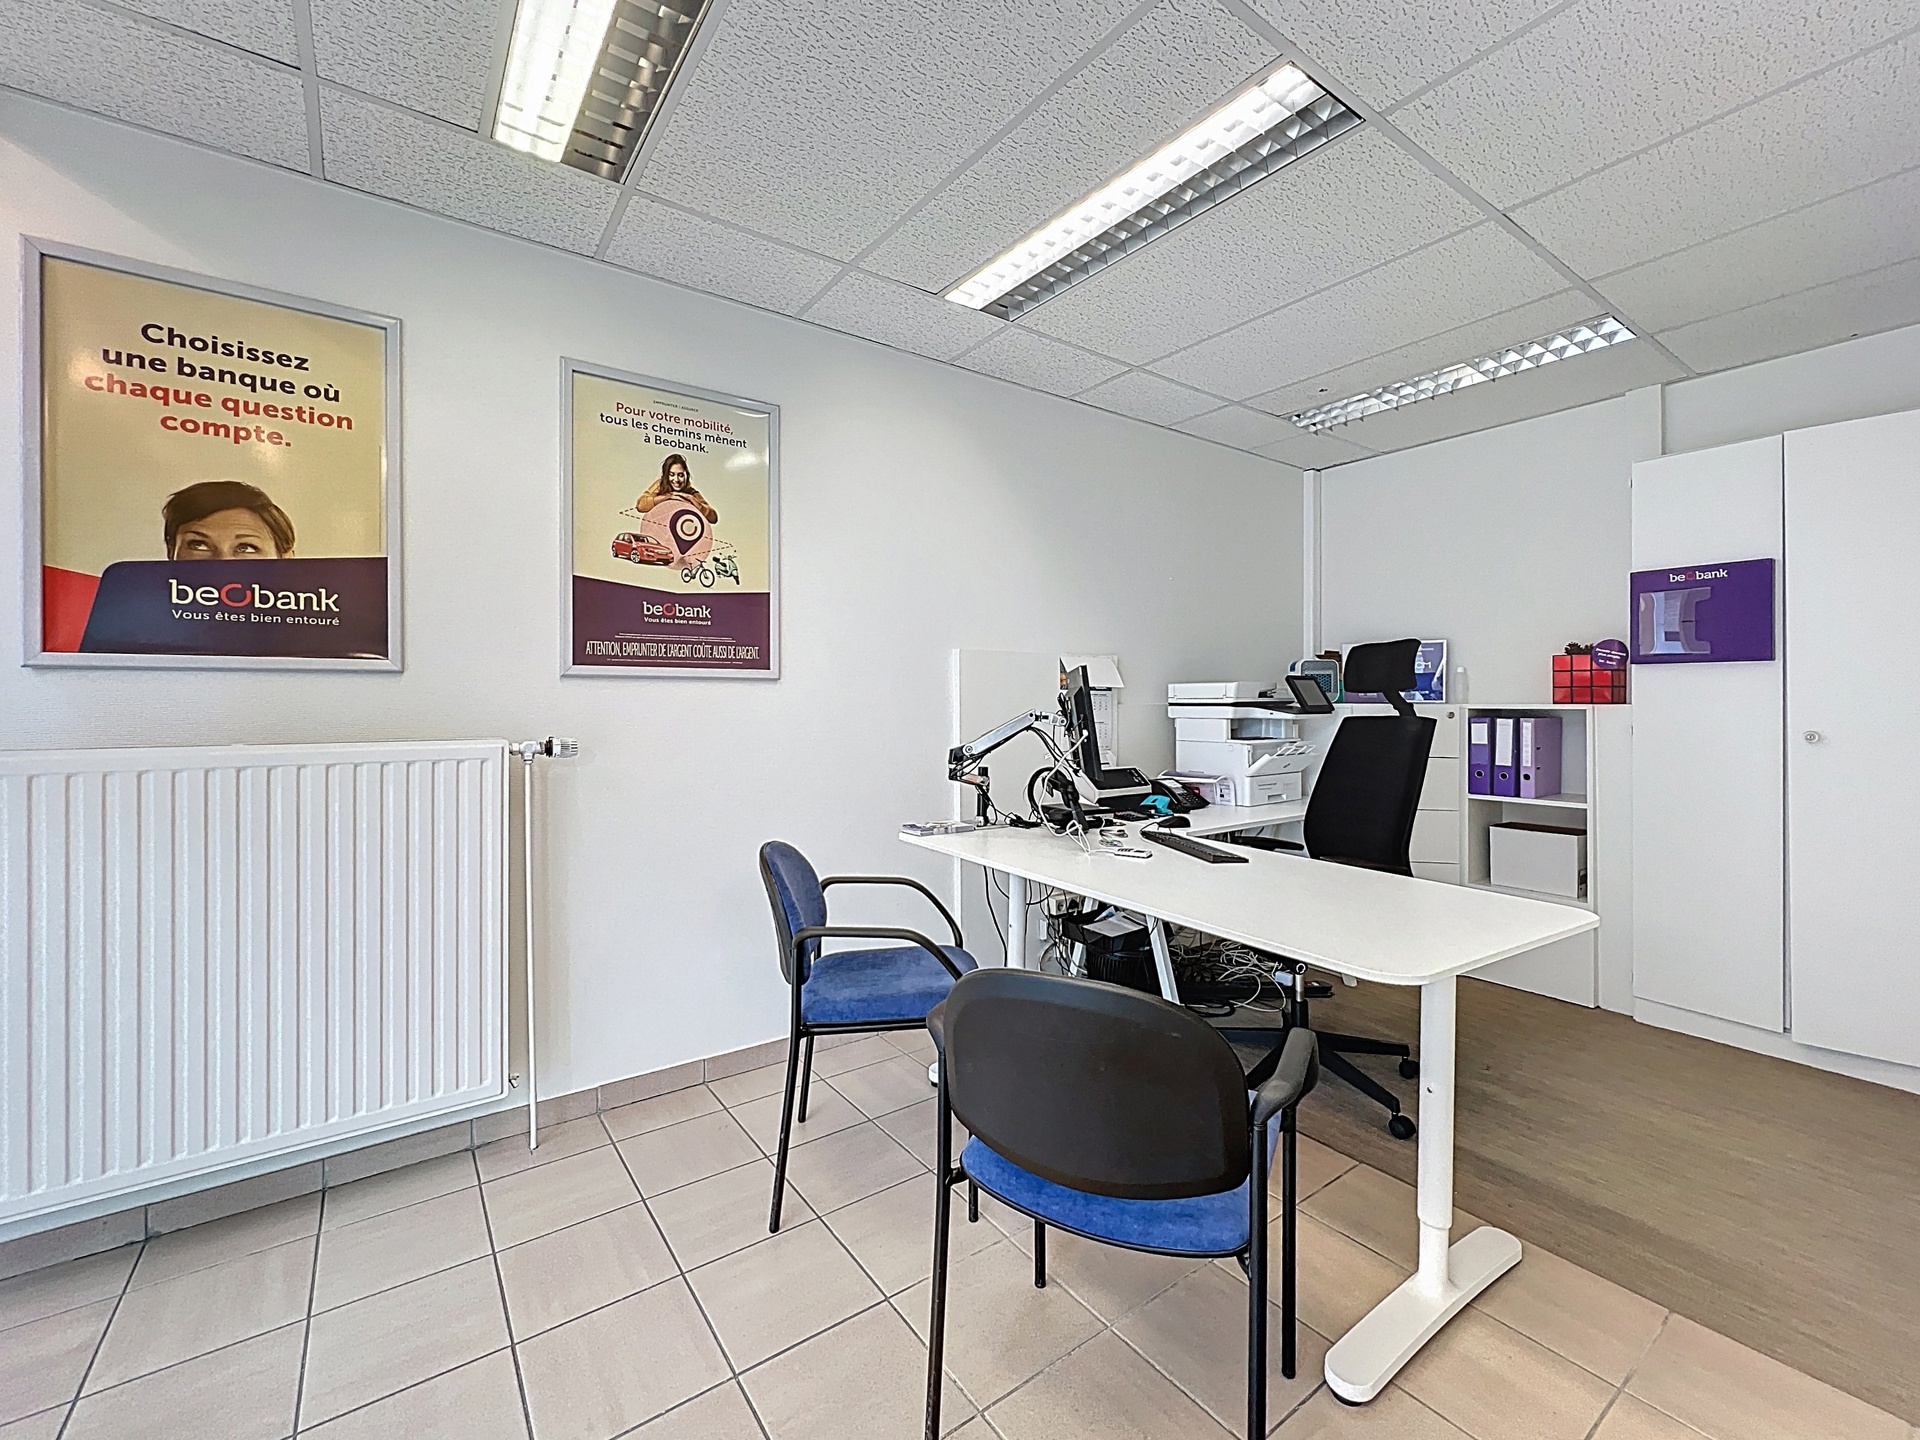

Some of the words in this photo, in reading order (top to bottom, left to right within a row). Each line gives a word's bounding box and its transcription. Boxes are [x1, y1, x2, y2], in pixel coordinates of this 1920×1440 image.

[141, 323, 309, 371] Choisissez
[102, 348, 167, 373] une
[177, 356, 296, 395] banque
[303, 383, 340, 402] où
[84, 373, 212, 407] chaque
[221, 396, 353, 430] question
[160, 415, 292, 447] compte.
[600, 412, 628, 427] tous
[631, 418, 649, 430] les
[651, 423, 701, 440] chemins
[704, 434, 747, 448] mènent
[616, 402, 646, 416] Pour
[648, 411, 680, 424] votre
[684, 417, 734, 435] mobilité,
[643, 433, 651, 443] à
[654, 434, 709, 454] Beobank.
[172, 609, 210, 620] Vous
[215, 611, 246, 622] êtes
[251, 612, 281, 624] bien
[286, 615, 340, 626] entouré
[586, 640, 622, 657] ATTENTION,
[622, 641, 658, 657] EMPRUNTER
[658, 643, 666, 657] DE
[667, 643, 693, 658] L'ARGENT
[693, 642, 712, 658] COÛTE
[712, 645, 728, 659] AUSSI
[727, 646, 736, 659] DE
